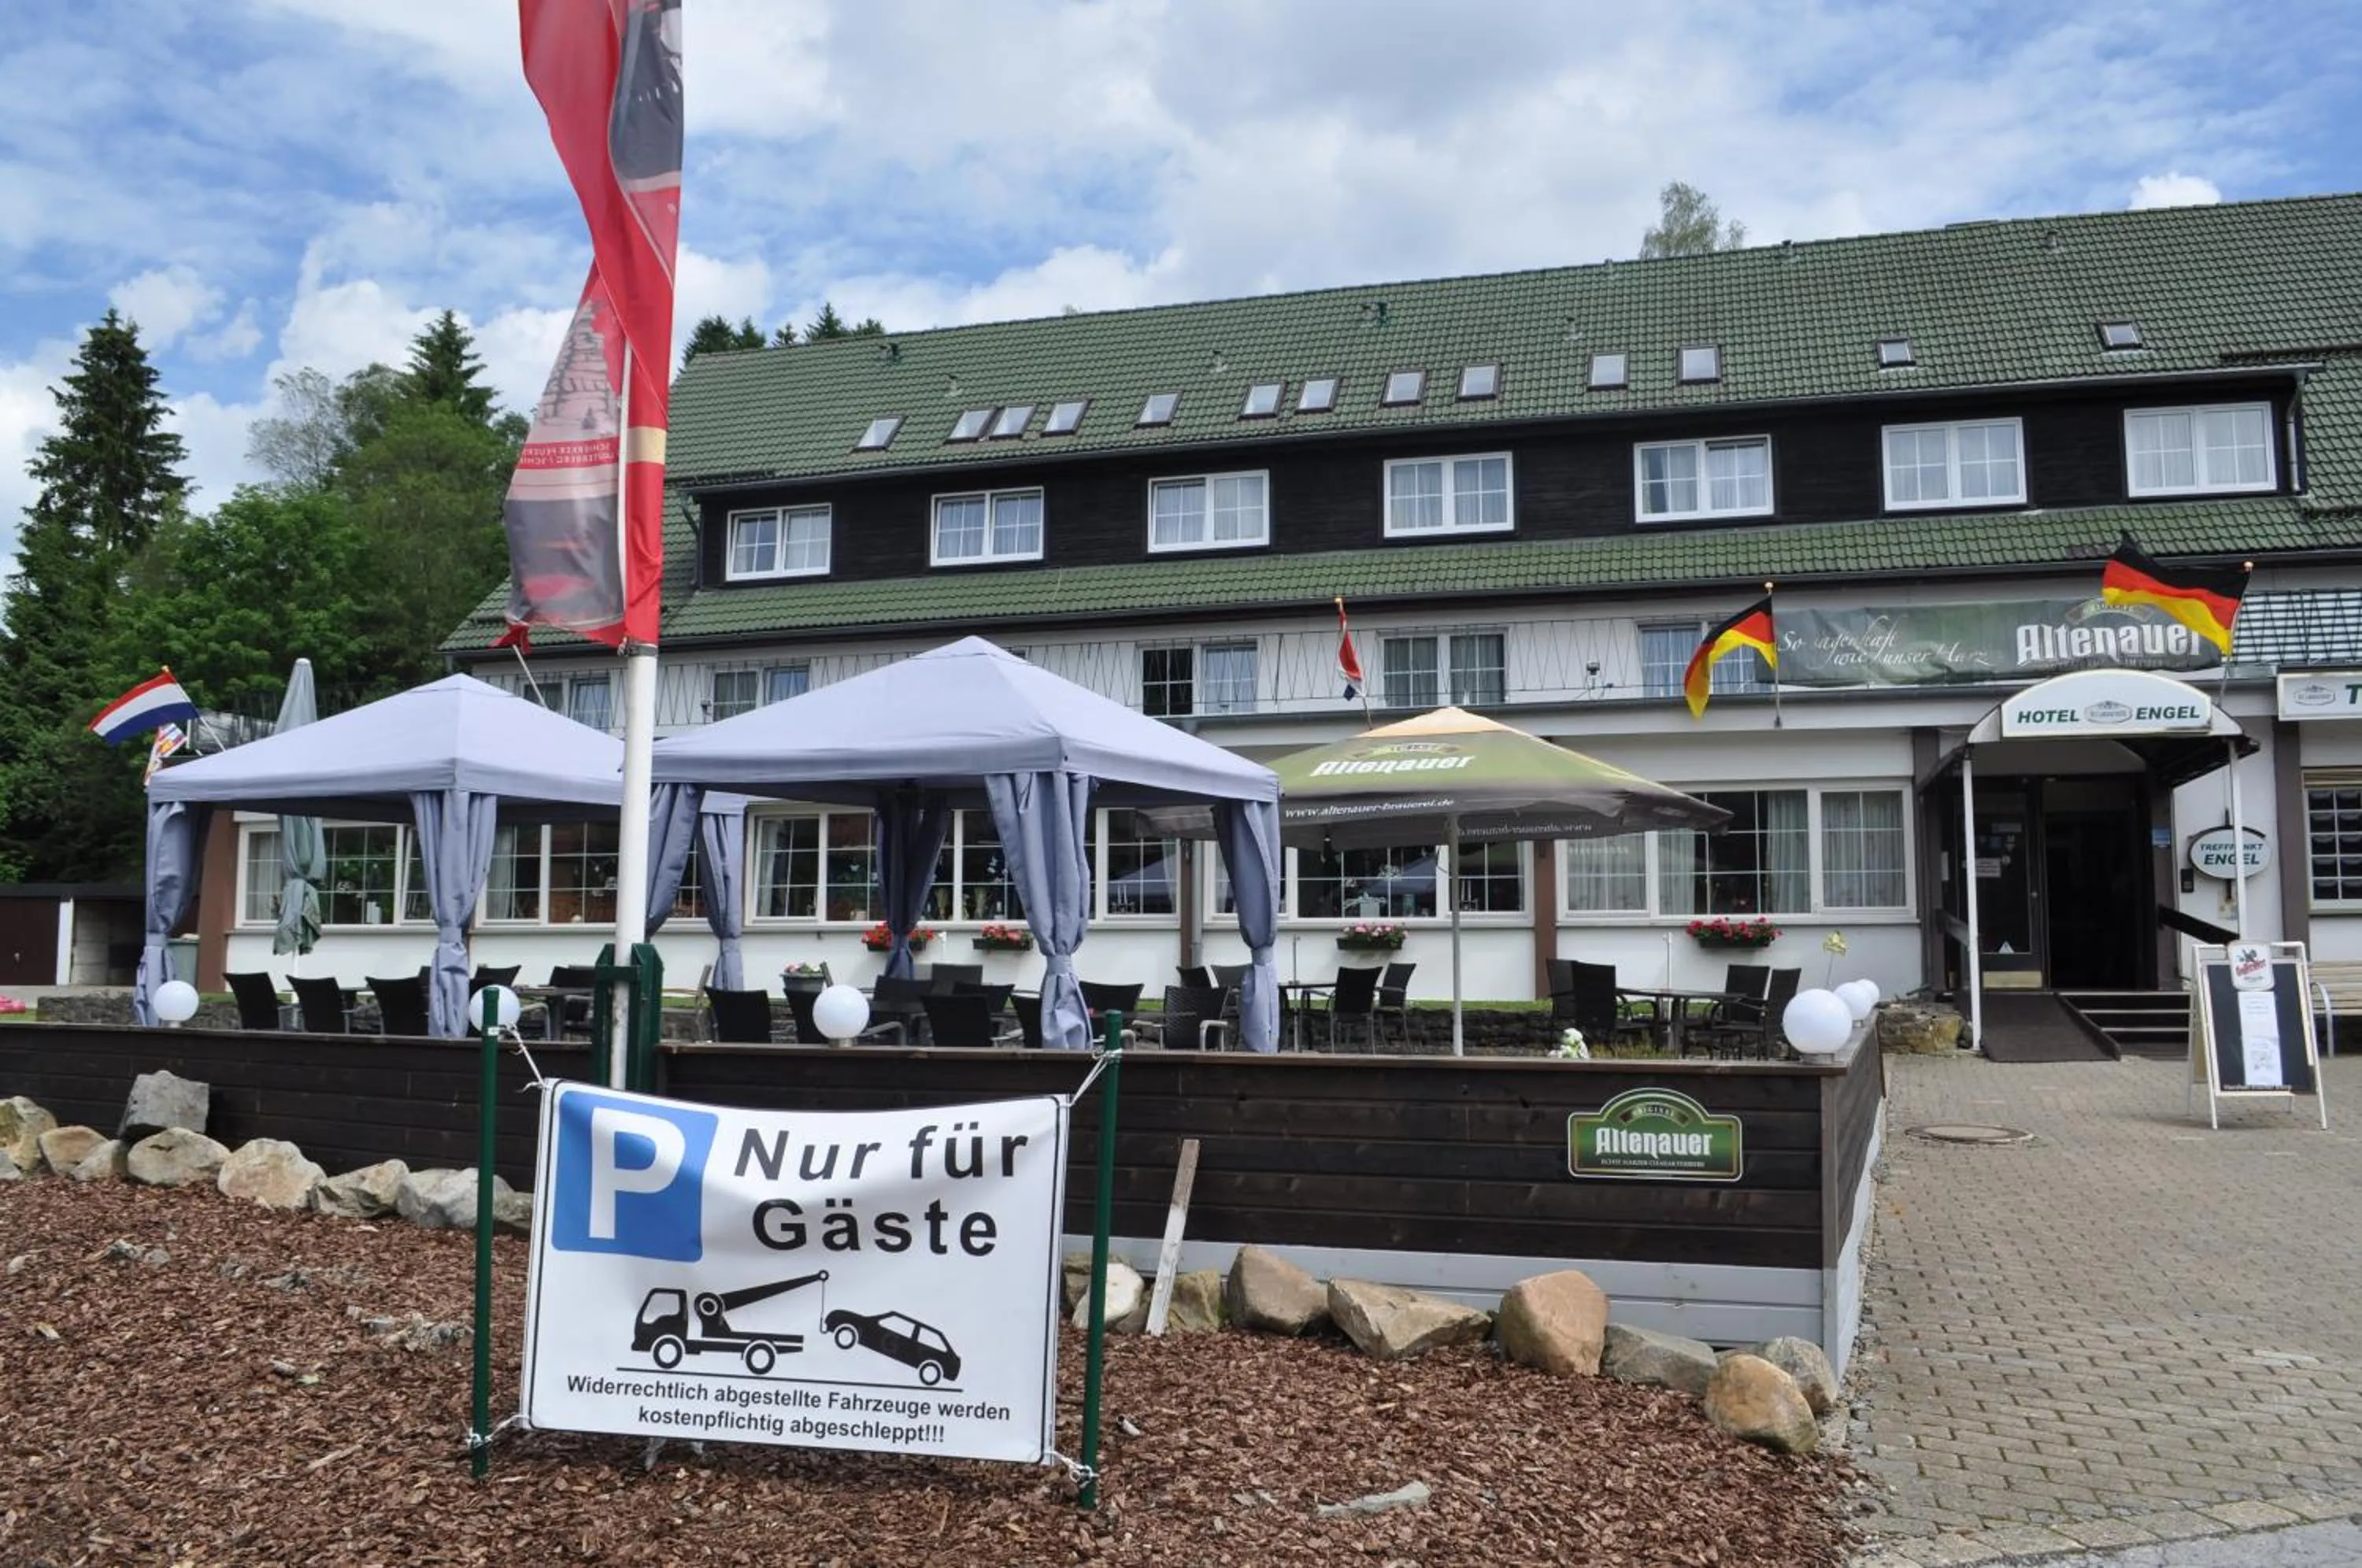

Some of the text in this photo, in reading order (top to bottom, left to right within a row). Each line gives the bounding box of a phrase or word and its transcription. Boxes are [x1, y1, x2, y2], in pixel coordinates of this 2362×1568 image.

[1778, 630, 1806, 652] So
[1882, 651, 1933, 666] unser
[2016, 623, 2201, 667] Altenauer
[2018, 710, 2079, 723] HOTEL
[2136, 706, 2201, 719] ENGEL
[1309, 755, 1476, 777] Altenauer
[1285, 798, 1454, 819] www.altenauer-brauerei.de
[734, 1121, 1028, 1181] Nur für
[1596, 1127, 1713, 1159] Altenauer
[589, 1108, 686, 1240] P
[752, 1198, 998, 1257] Gäste
[567, 1375, 1011, 1421] Widerrechtlich abgestellte Fahrzeuge werden
[638, 1406, 945, 1444] kostenpflichtig abgeschleppt!!!
